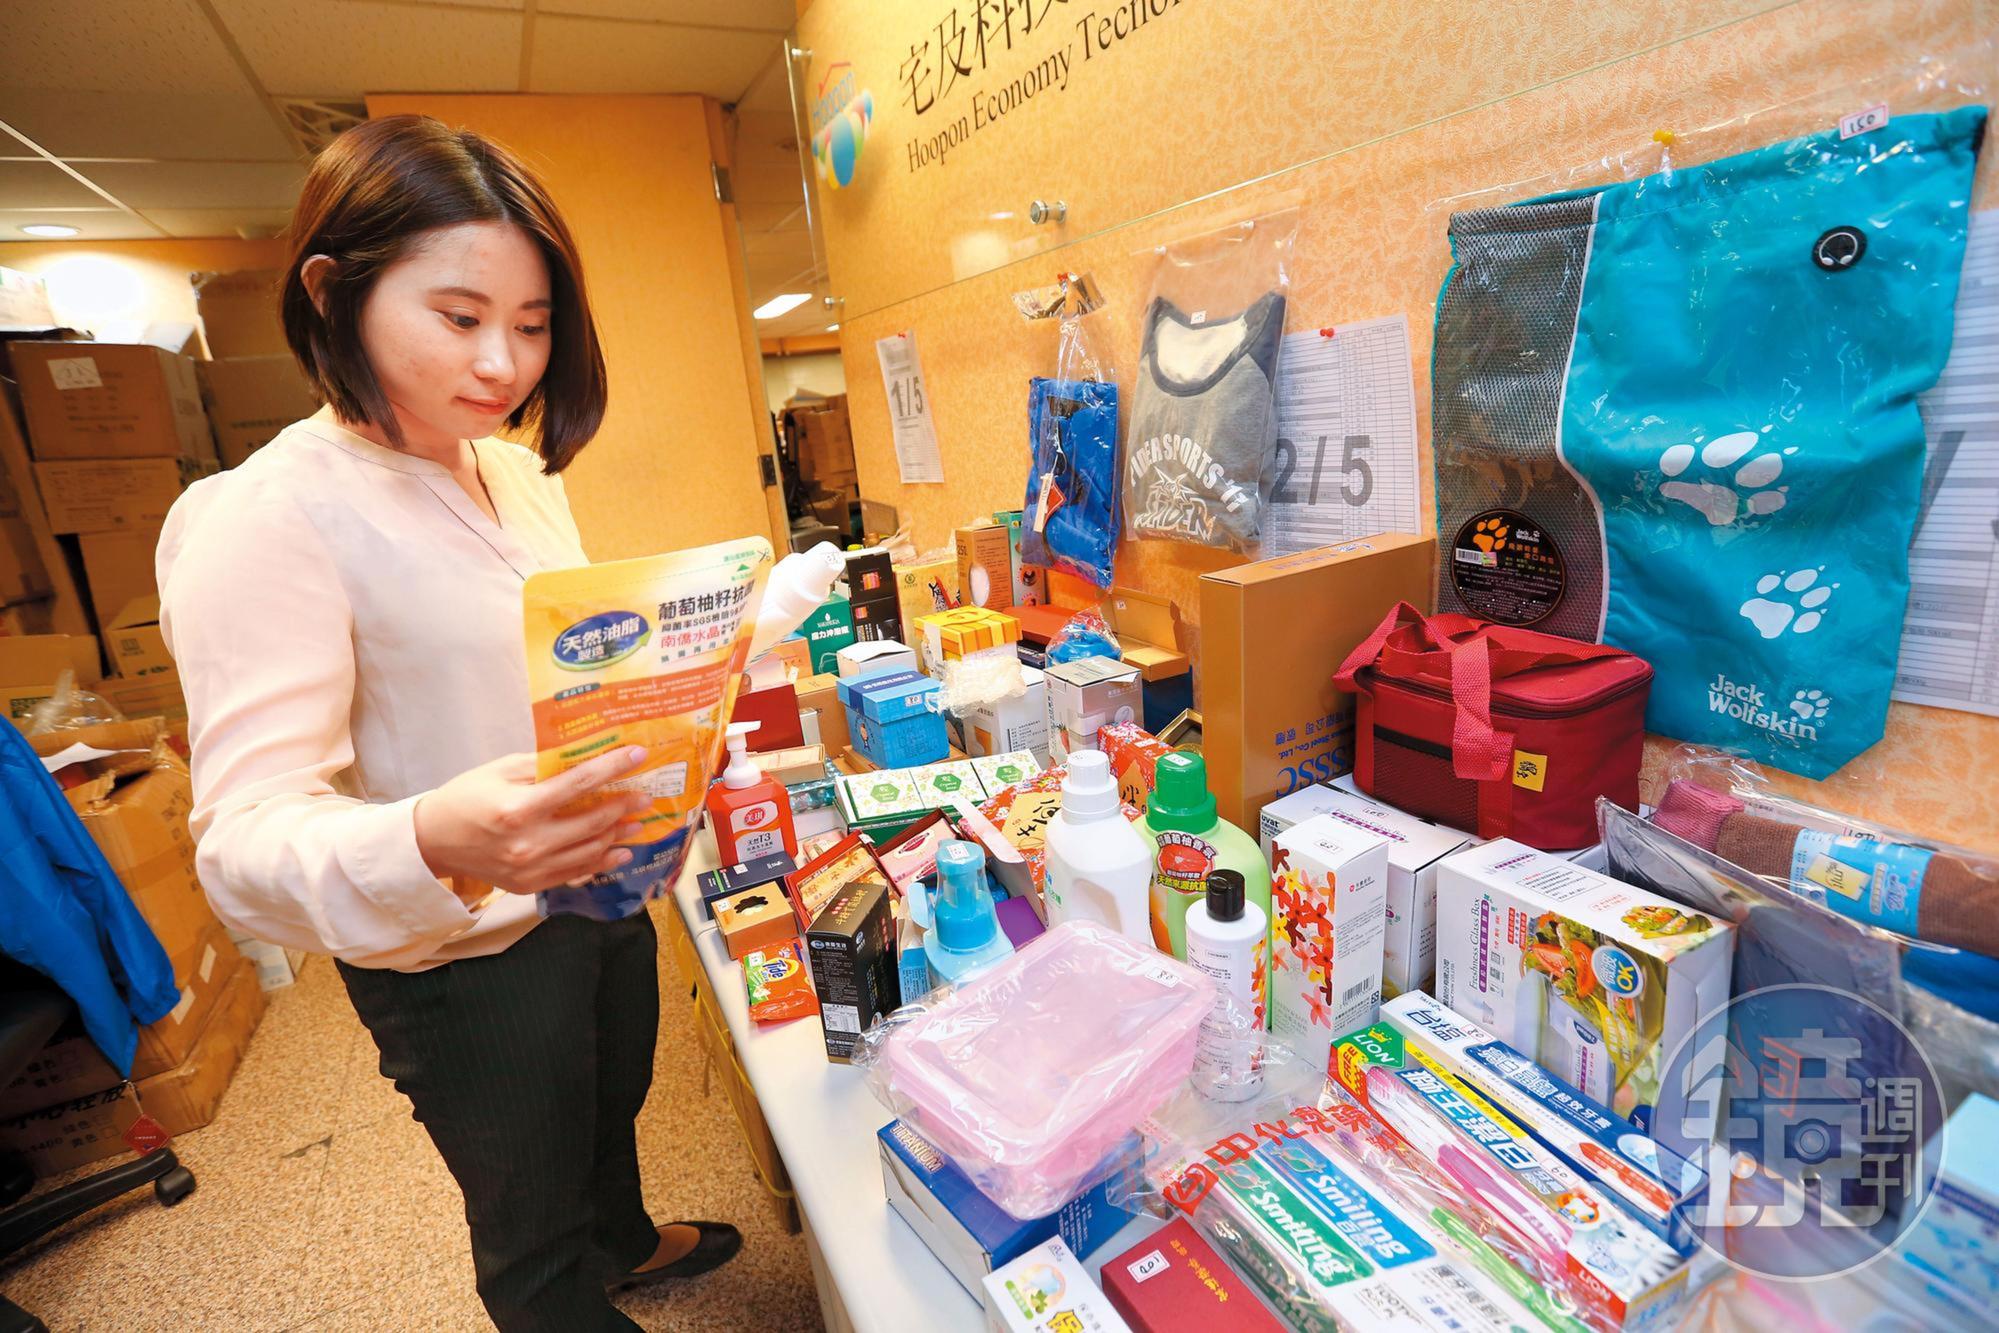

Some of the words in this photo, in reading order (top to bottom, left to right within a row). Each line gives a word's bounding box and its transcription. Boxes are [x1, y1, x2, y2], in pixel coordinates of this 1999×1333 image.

[906, 115, 969, 173] Hoopon
[971, 43, 1072, 132] Economy
[890, 375, 924, 418] 1/5
[1269, 434, 1374, 508] 2/5
[562, 616, 640, 656] 天然油脂
[1709, 673, 1766, 708] Jack
[1707, 690, 1818, 742] Wolfskin
[1470, 897, 1480, 917] Box
[1469, 919, 1479, 946] Glass
[761, 959, 787, 979] Tide
[1469, 945, 1479, 991] Freshness
[1614, 964, 1636, 992] OK
[1342, 1046, 1359, 1082] FREE
[1352, 1034, 1396, 1063] LION
[888, 1120, 946, 1174] TITANIUM
[1305, 1174, 1411, 1260] Smiling
